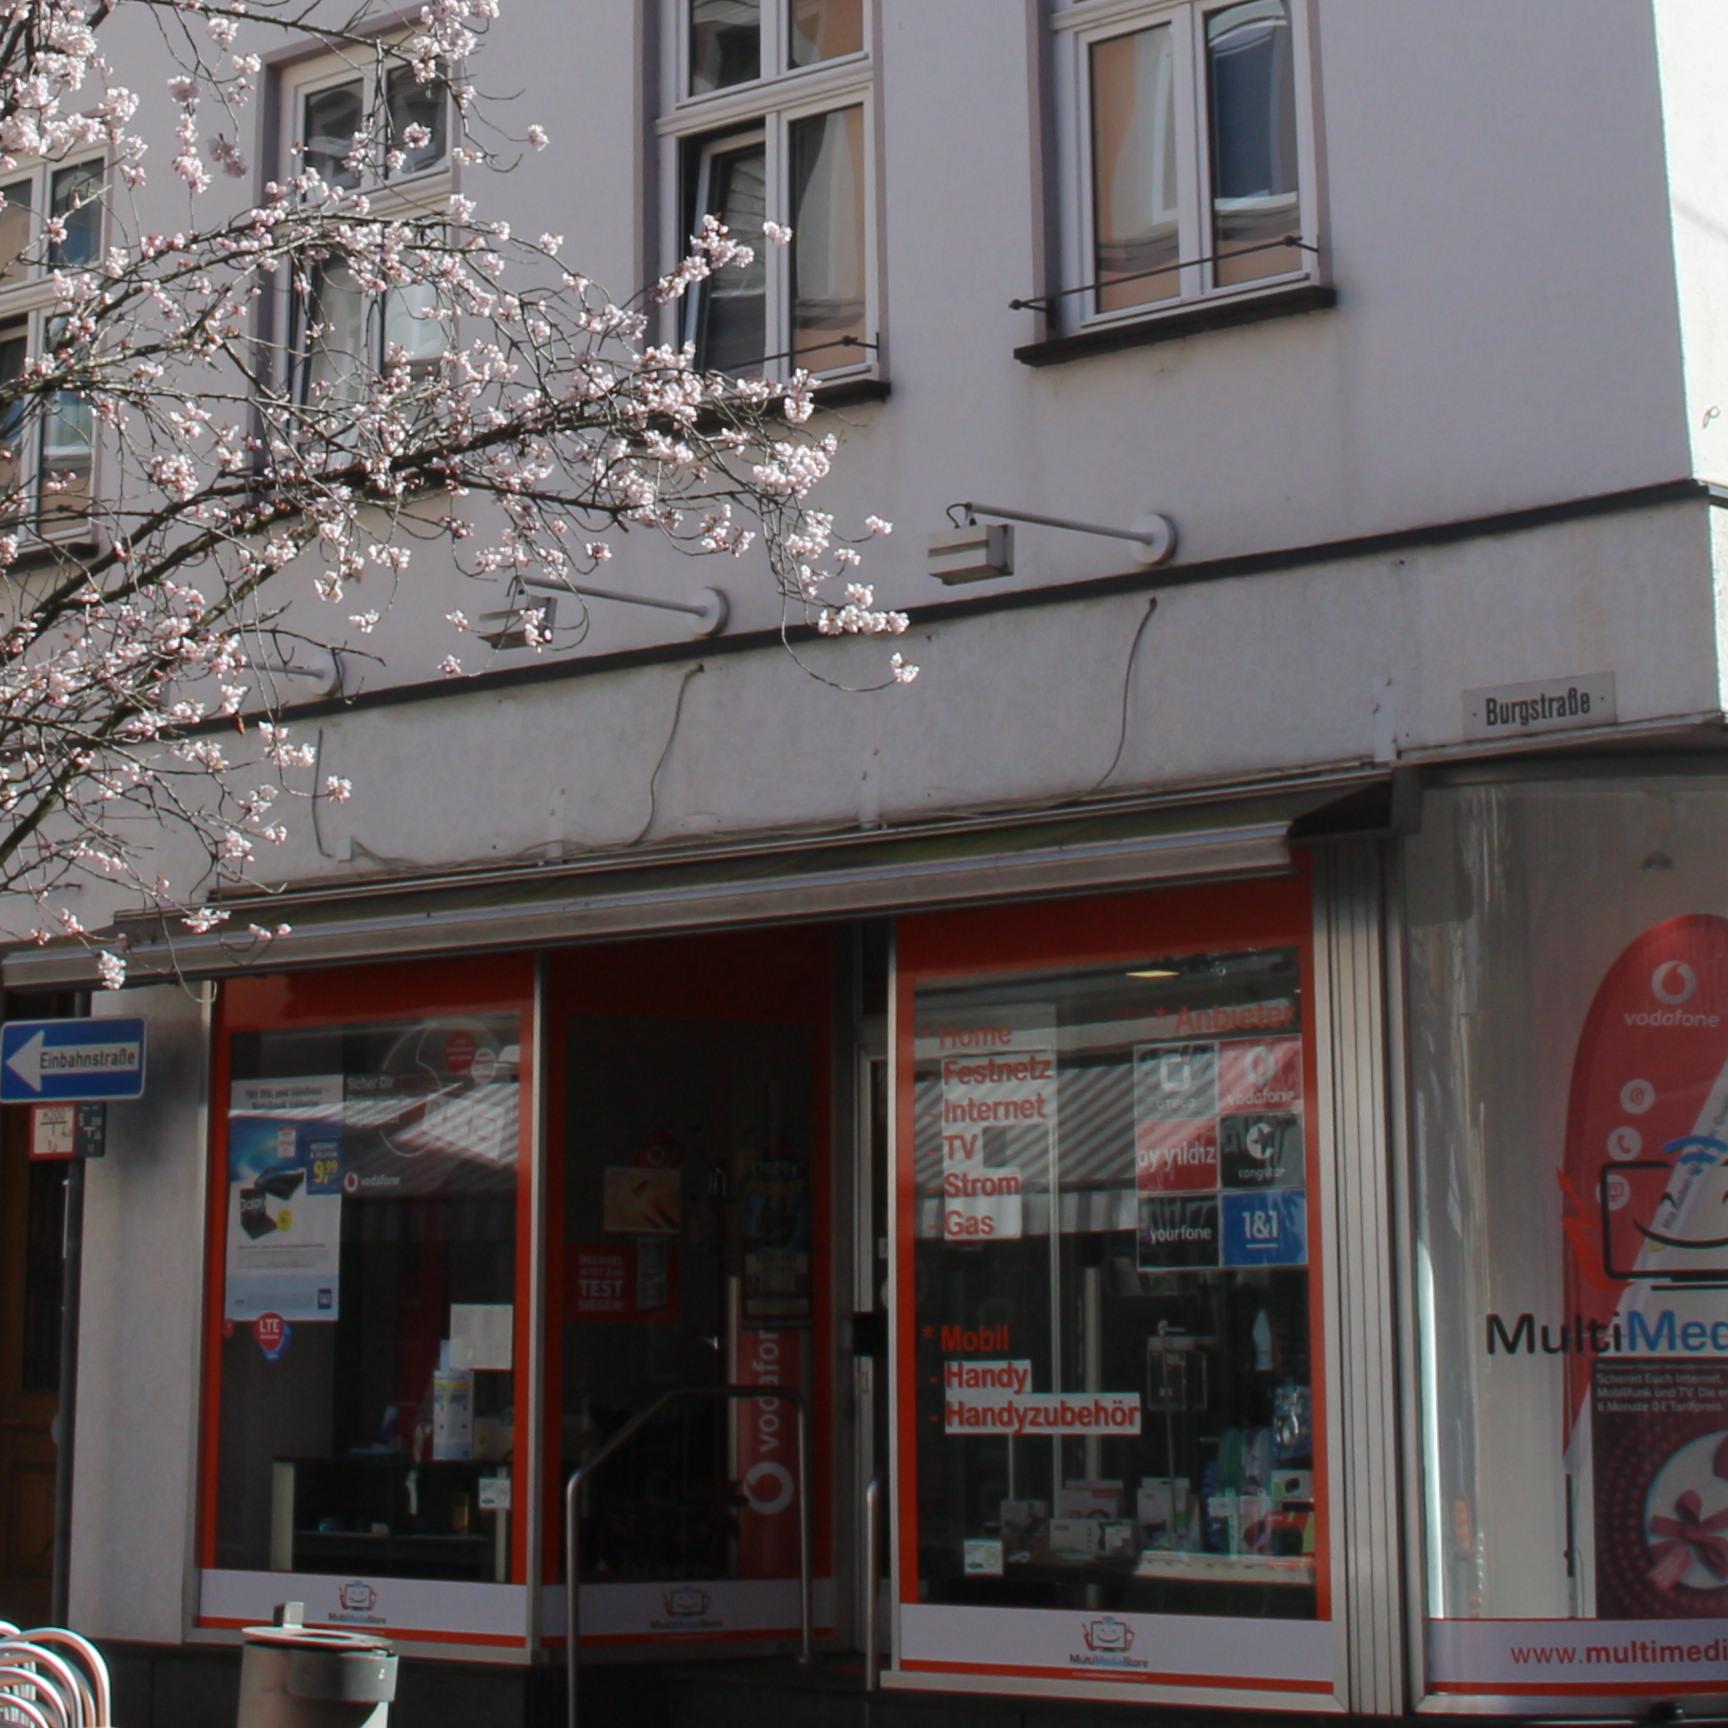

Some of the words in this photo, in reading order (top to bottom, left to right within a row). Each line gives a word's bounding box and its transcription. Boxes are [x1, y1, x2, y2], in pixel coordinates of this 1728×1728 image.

[1485, 686, 1591, 726] Burgstraße
[1174, 1003, 1296, 1031] Anbieter
[1623, 1008, 1721, 1028] vodafone
[938, 1023, 1012, 1050] Home
[39, 1048, 136, 1070] Einbahnstraße
[943, 1056, 1053, 1086] Festnetz
[943, 1092, 1046, 1123] Internet
[1226, 1087, 1296, 1106] vodafone
[942, 1133, 978, 1161] TV
[1137, 1147, 1160, 1165] ay
[943, 1172, 1021, 1199] Strom
[943, 1210, 995, 1236] Gas
[1149, 1225, 1213, 1245] yourfone
[1241, 1210, 1280, 1240] 1&1
[577, 1279, 624, 1297] TEST
[259, 1319, 280, 1334] LTE
[940, 1324, 1010, 1352] Mobil
[944, 1361, 1029, 1394] Handy
[944, 1399, 1141, 1436] Handyzubehör
